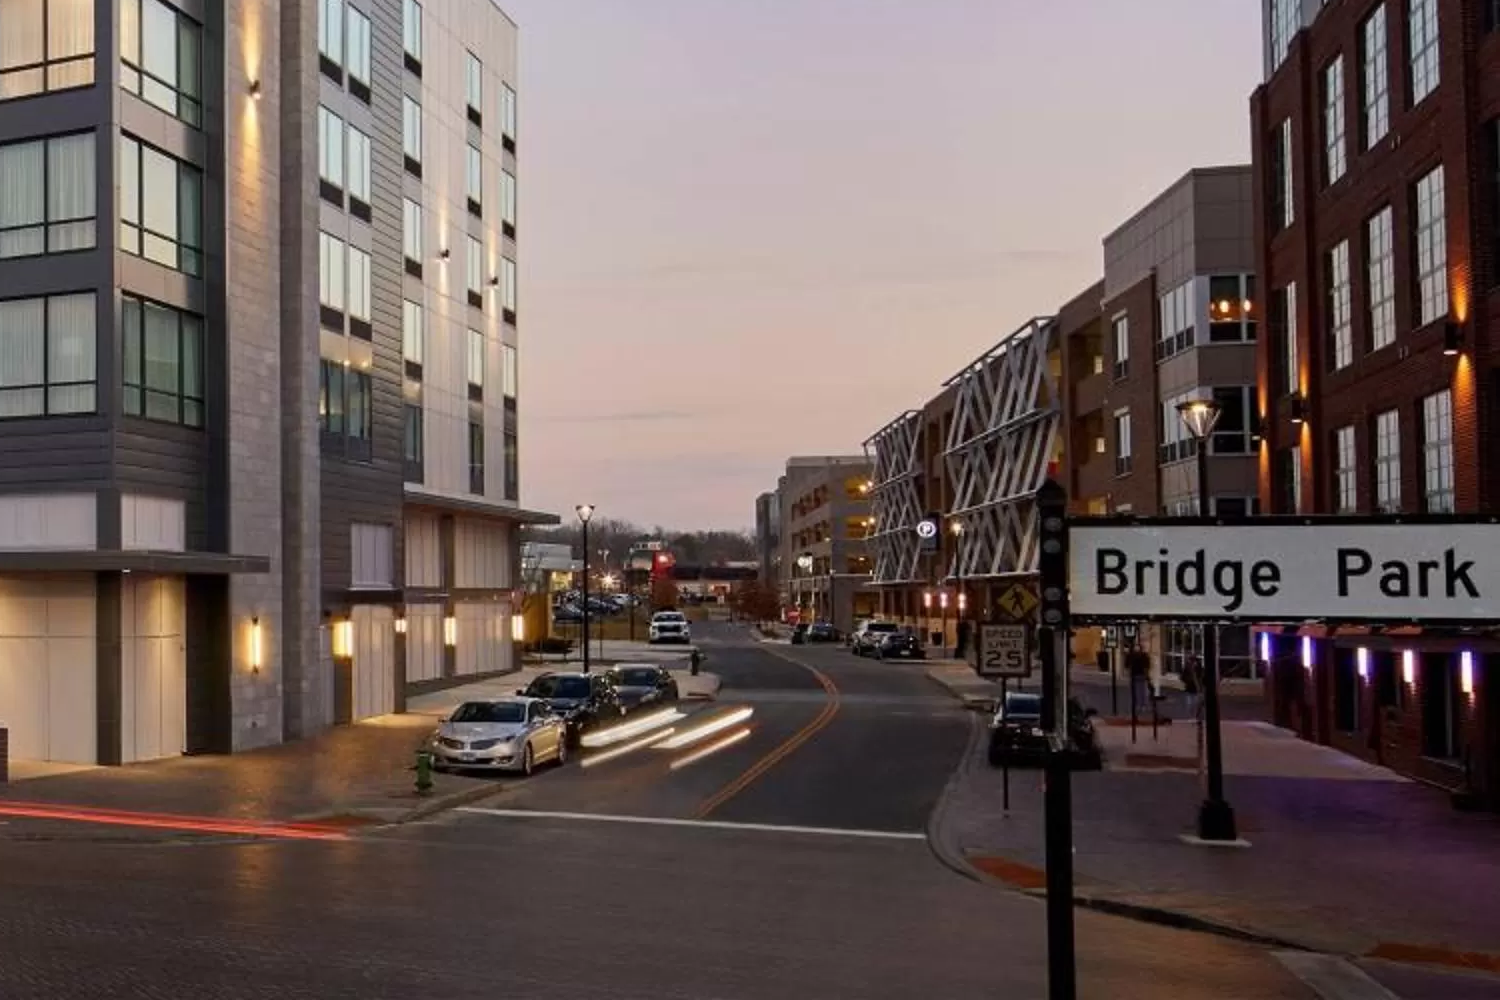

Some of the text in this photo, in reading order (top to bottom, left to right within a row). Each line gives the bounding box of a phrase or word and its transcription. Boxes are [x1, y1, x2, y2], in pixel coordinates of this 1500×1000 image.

[1095, 547, 1481, 613] Bridge Park
[985, 650, 1022, 669] 25
